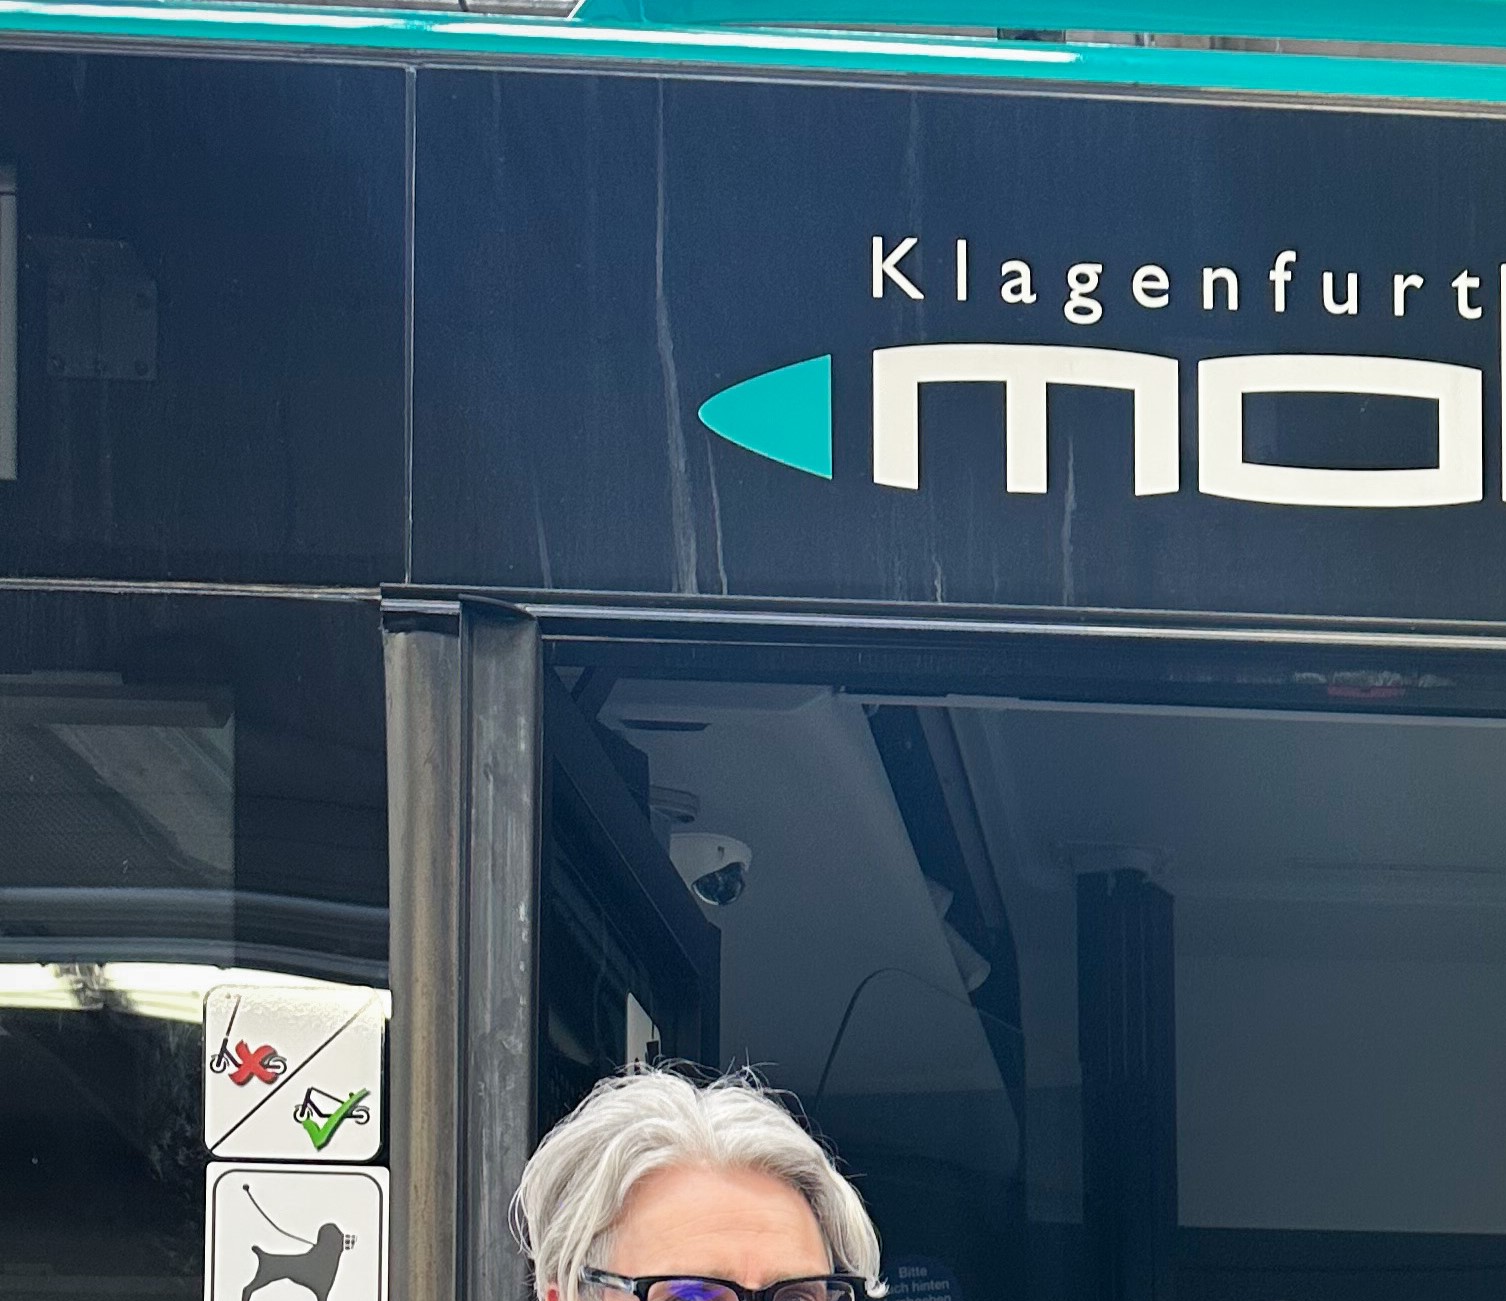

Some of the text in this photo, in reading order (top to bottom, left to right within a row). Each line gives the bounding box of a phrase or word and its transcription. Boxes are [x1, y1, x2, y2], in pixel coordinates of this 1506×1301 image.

[873, 237, 1482, 325] Klagenfurt
[898, 1266, 928, 1279] Bitte
[912, 1279, 950, 1292] hinten
